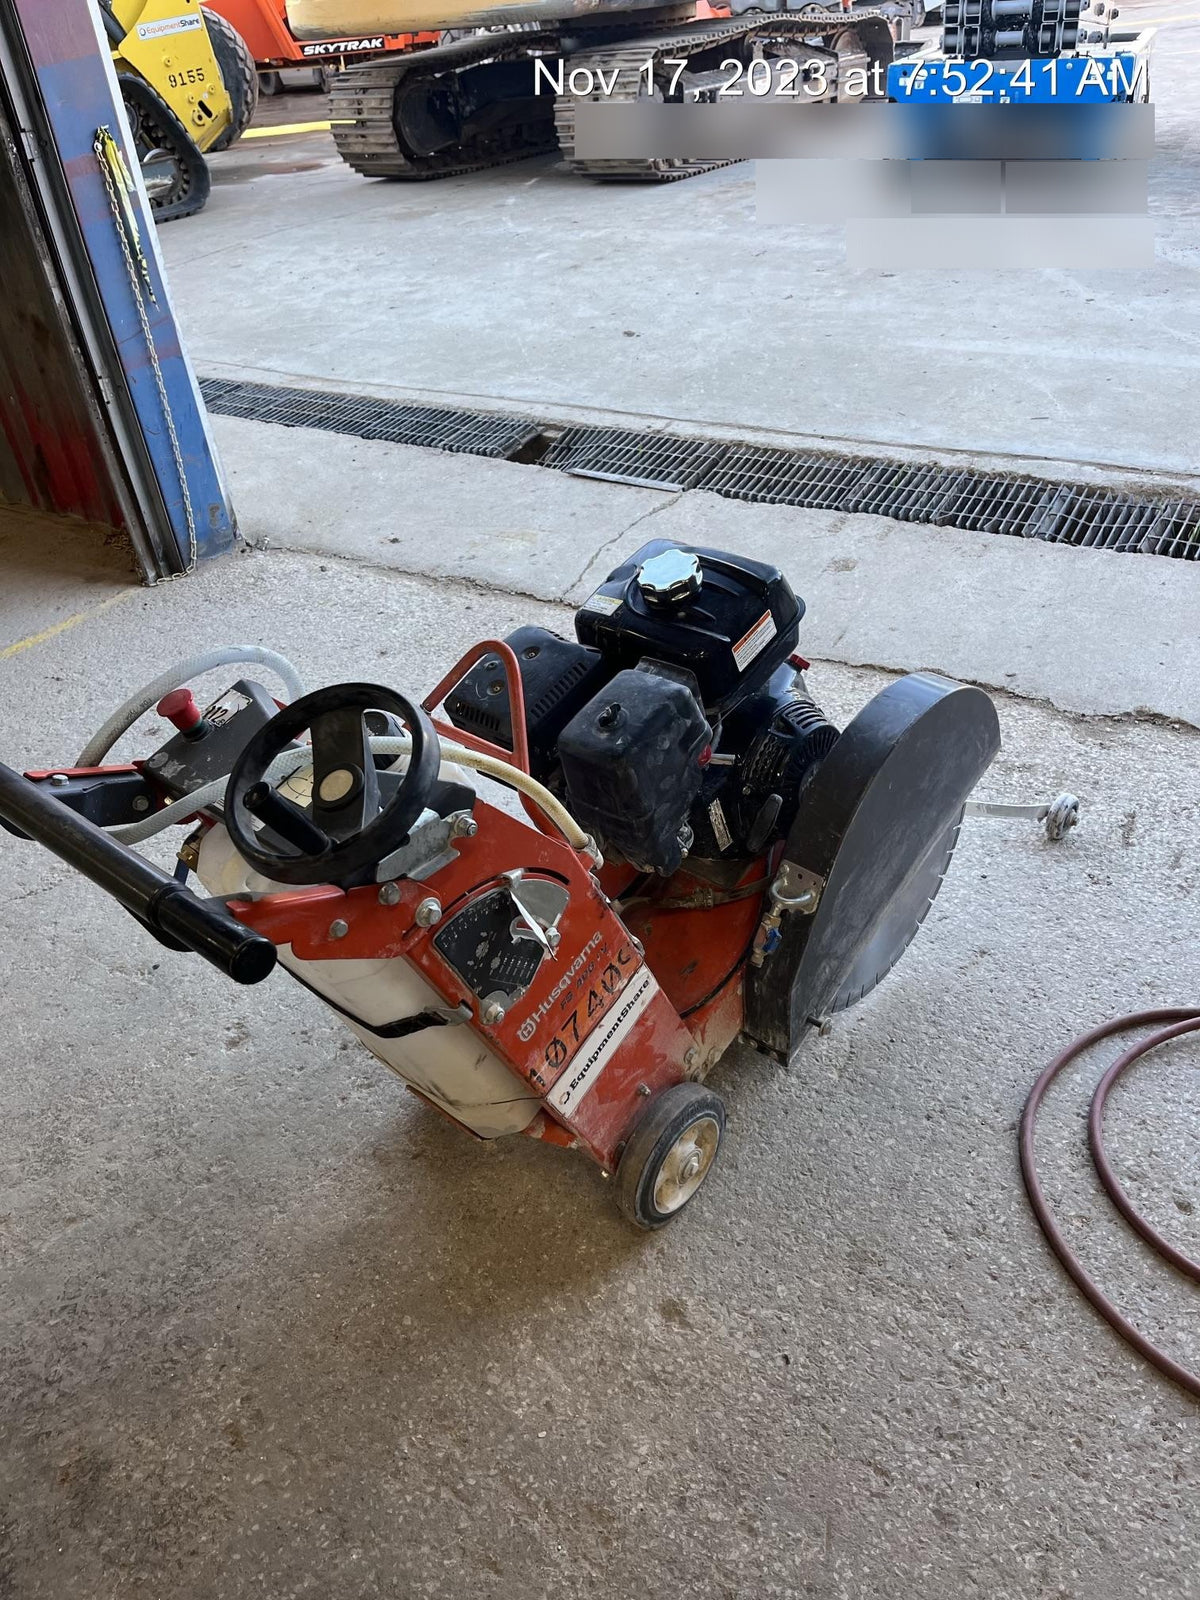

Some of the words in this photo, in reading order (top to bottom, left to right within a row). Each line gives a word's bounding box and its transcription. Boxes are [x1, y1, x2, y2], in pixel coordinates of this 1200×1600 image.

[146, 18, 199, 34] EquipmentShare
[303, 38, 382, 56] SKYTRAK
[168, 68, 205, 88] 9155
[532, 931, 602, 1022] Husqvarna
[570, 979, 650, 1091] EquipmentShare
